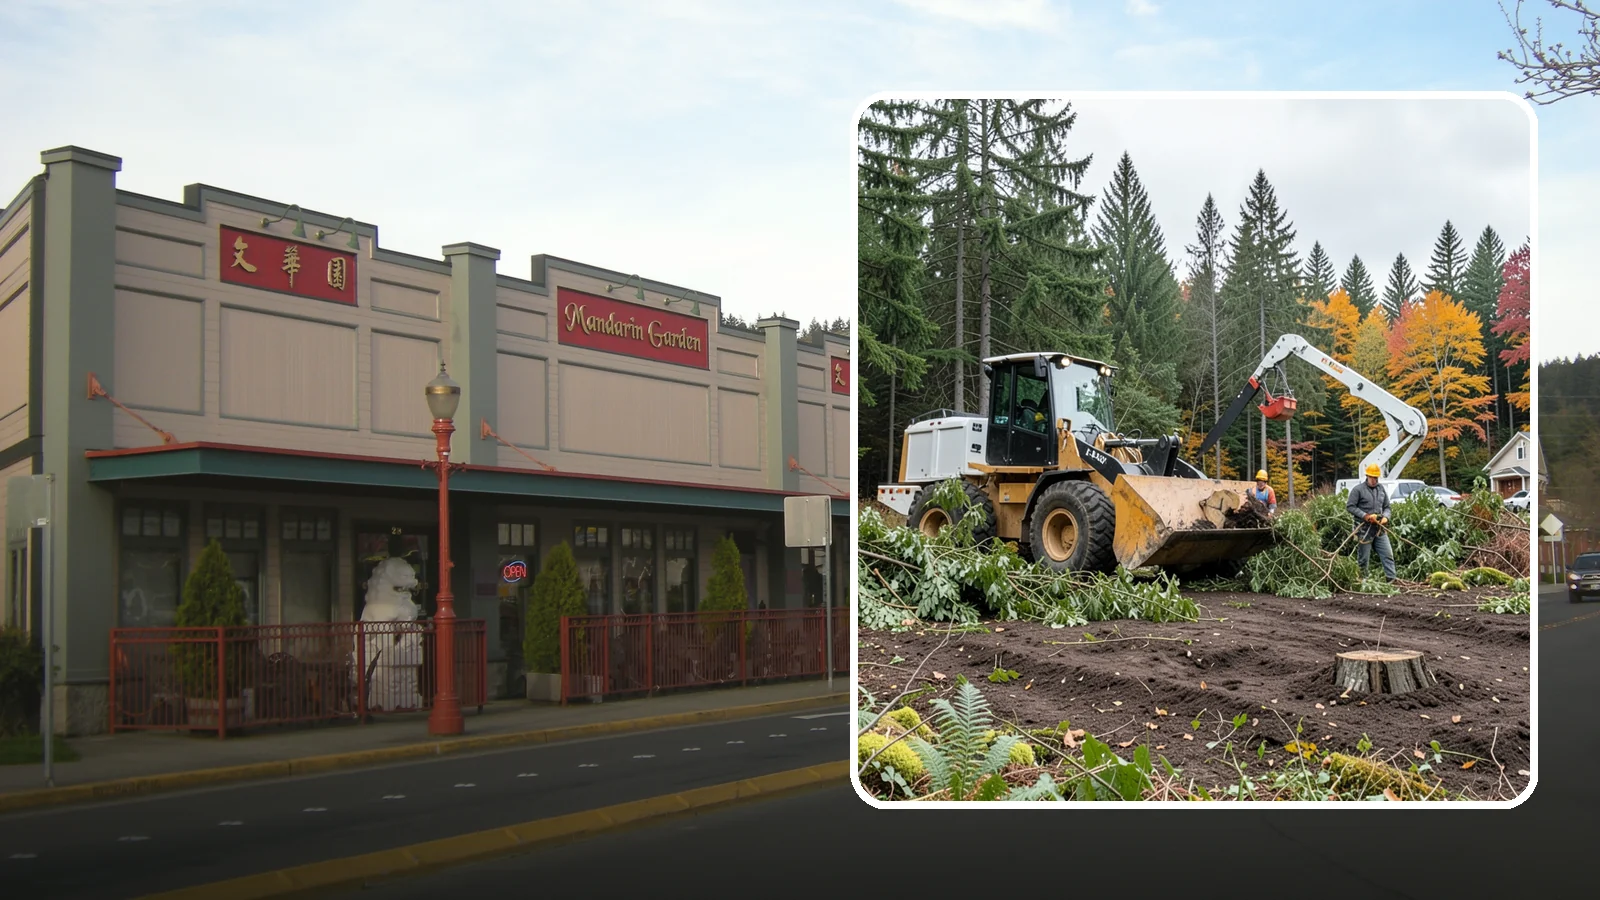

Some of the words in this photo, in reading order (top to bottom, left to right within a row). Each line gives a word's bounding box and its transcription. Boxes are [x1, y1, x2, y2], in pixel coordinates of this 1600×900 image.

[564, 302, 644, 341] Mandarin
[648, 320, 701, 352] Garden
[503, 565, 527, 578] OPEN
